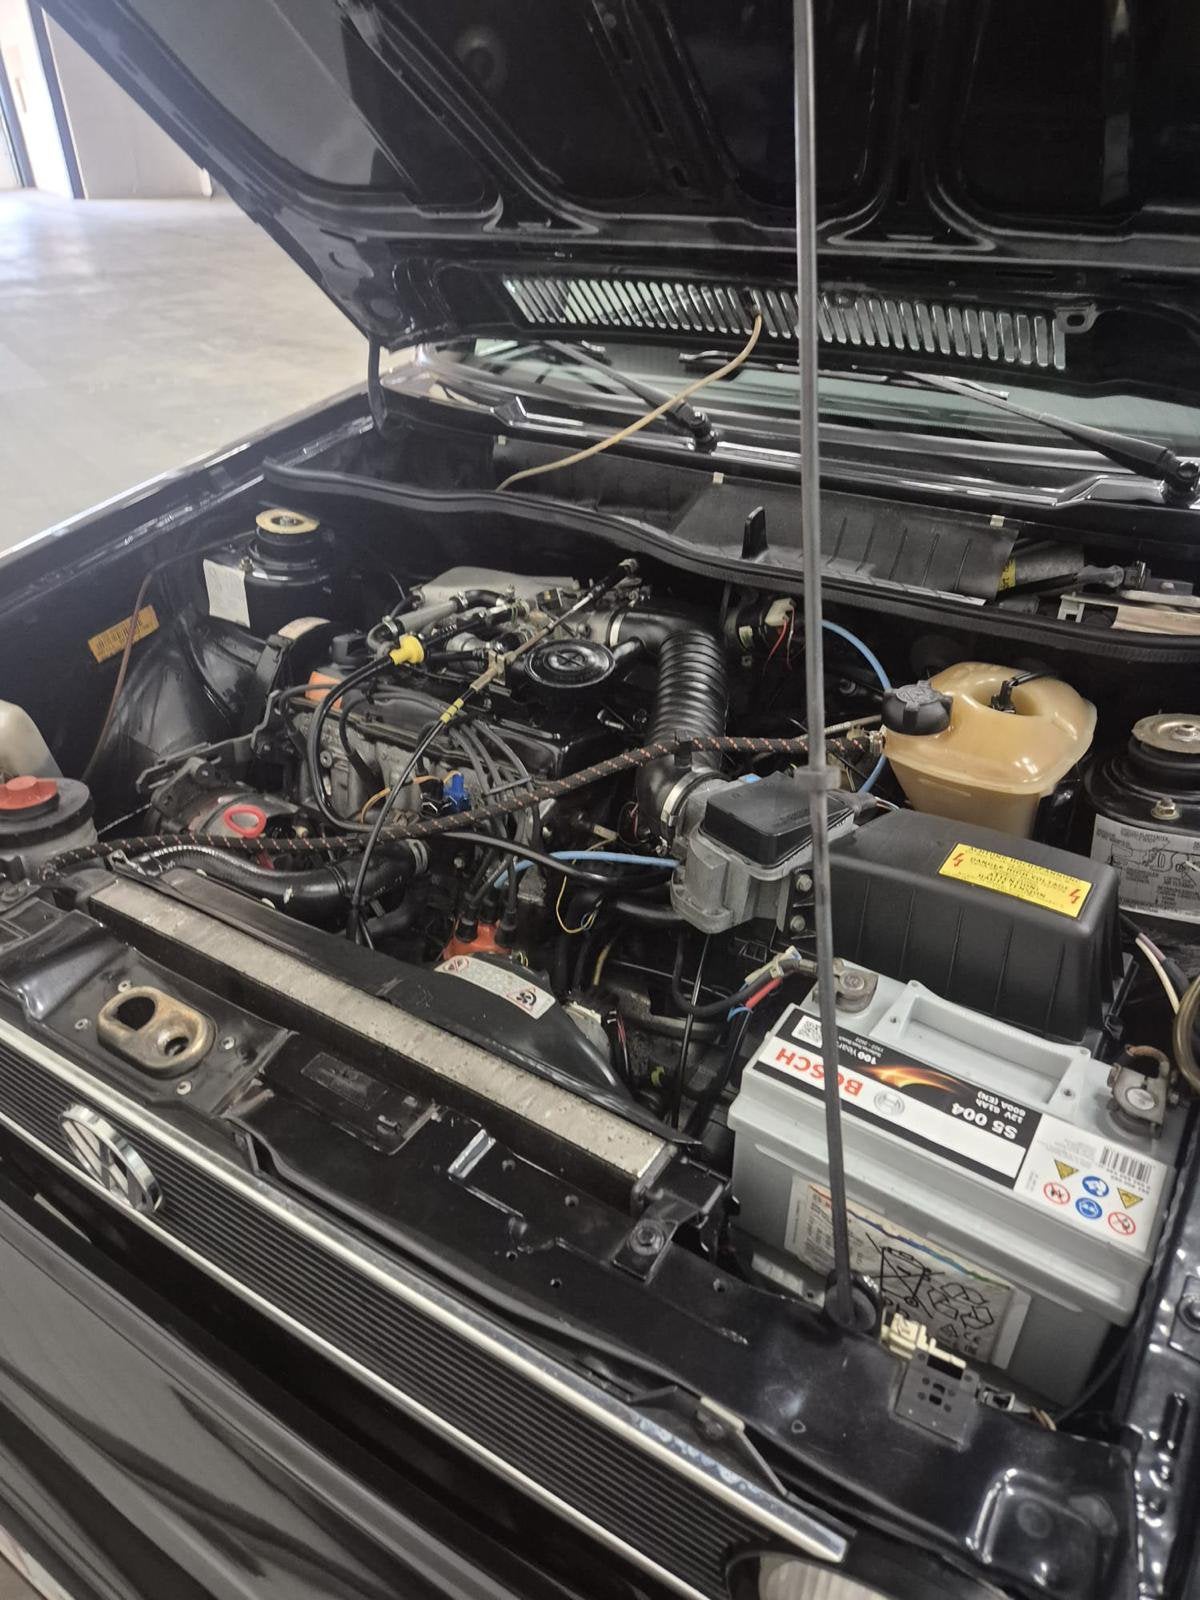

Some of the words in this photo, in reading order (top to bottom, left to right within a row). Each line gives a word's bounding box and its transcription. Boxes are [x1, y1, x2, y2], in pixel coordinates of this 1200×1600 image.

[857, 1050, 877, 1065] 100
[951, 1102, 988, 1127] 004
[1003, 1111, 1023, 1124] 12V
[991, 1120, 1018, 1140] S5
